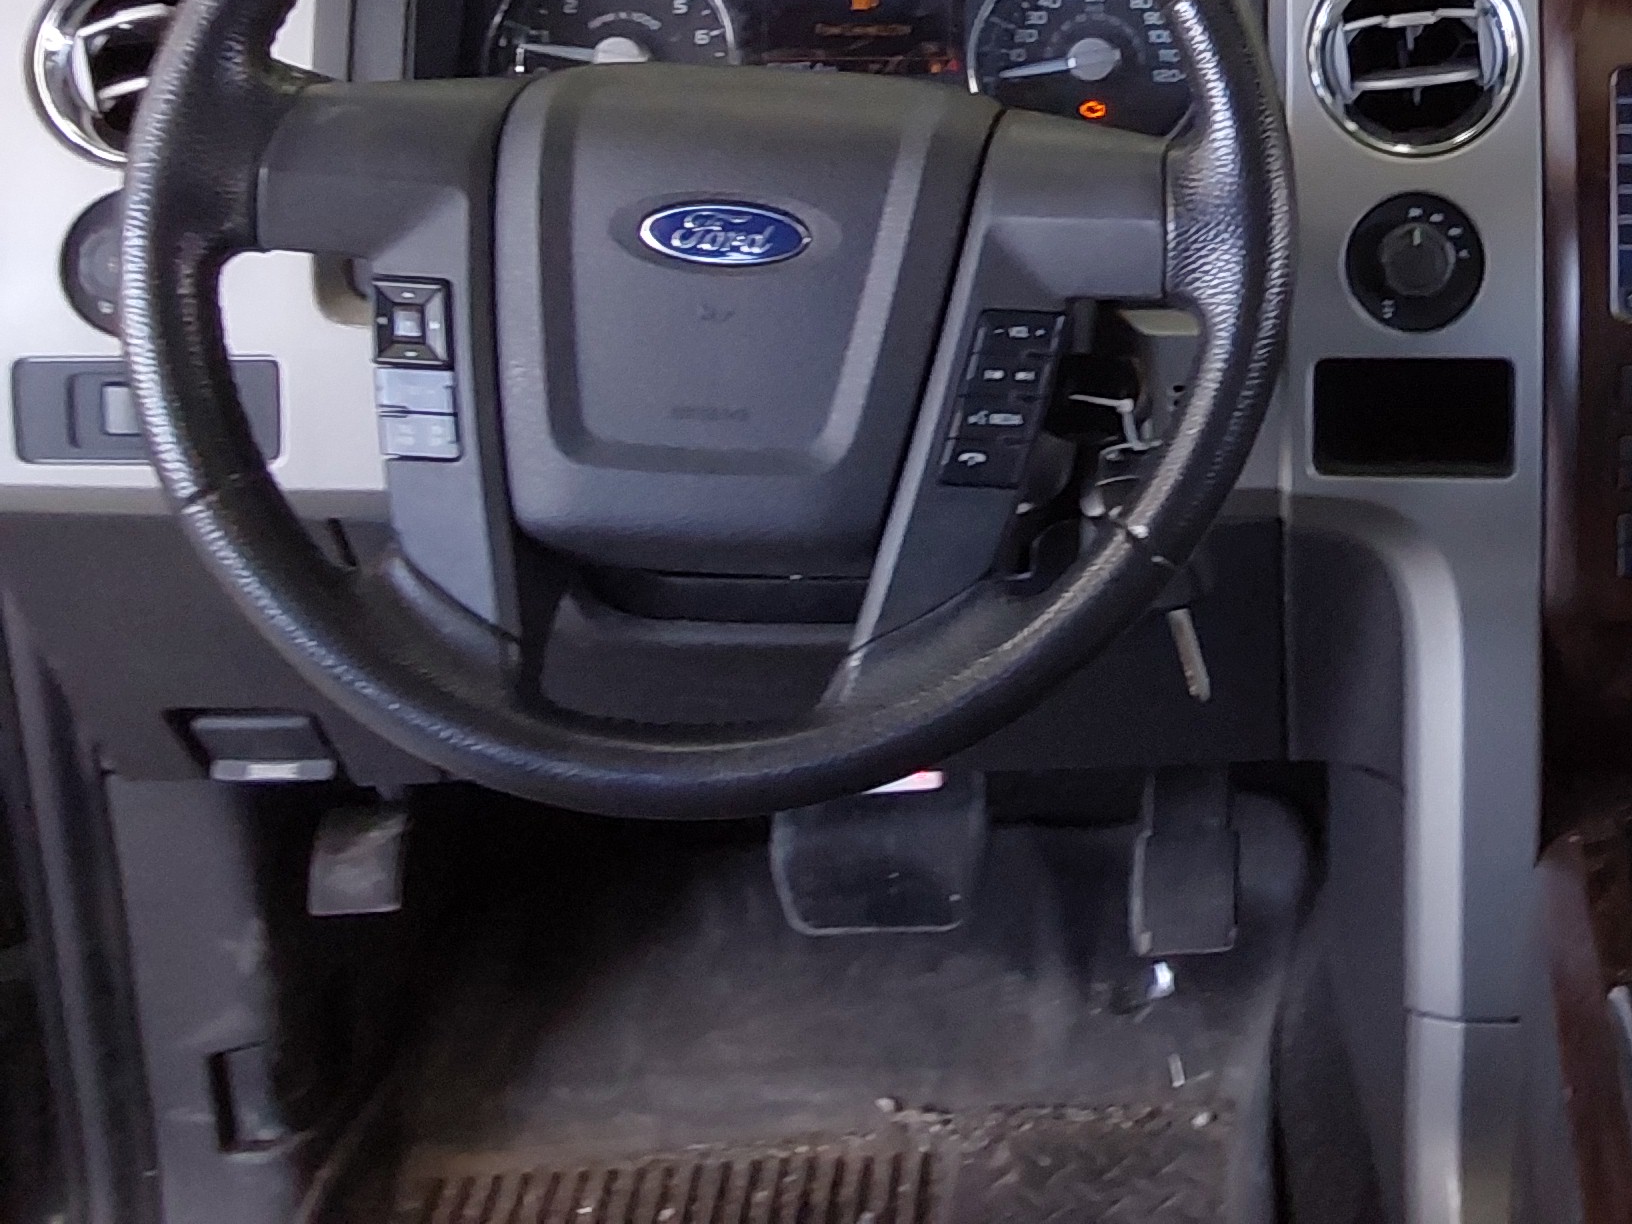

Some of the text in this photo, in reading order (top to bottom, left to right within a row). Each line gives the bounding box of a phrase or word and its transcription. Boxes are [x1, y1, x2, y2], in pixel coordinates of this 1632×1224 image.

[563, 0, 578, 14] 2
[672, 0, 688, 14] 5
[694, 30, 710, 44] 6
[670, 211, 773, 254] Ford
